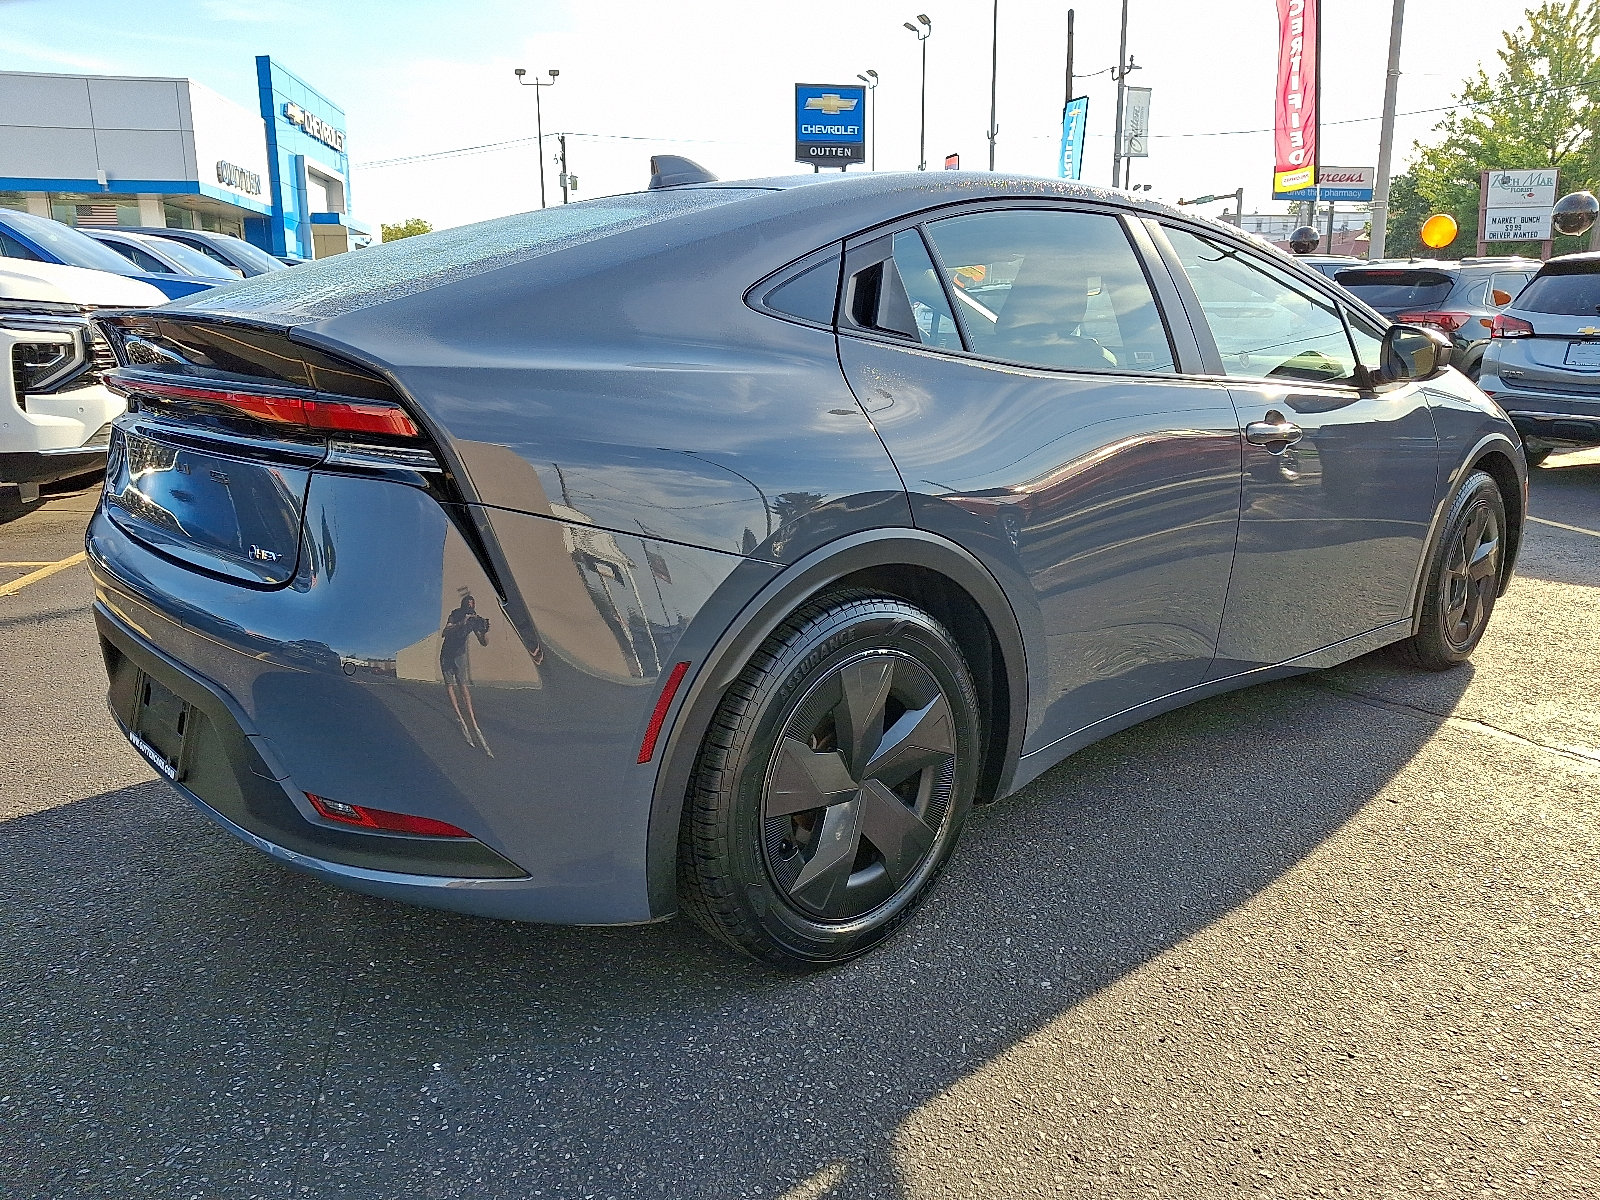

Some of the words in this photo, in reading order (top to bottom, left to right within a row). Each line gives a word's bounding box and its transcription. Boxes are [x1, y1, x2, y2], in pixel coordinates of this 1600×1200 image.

[303, 110, 345, 153] CHEVROLET
[801, 125, 860, 134] CHEVROLET
[810, 147, 852, 156] OUTTEN
[1324, 189, 1362, 198] pharmacy
[1491, 217, 1516, 225] MARKET
[1520, 216, 1541, 224] BUNCH
[1513, 231, 1539, 239] WANTED
[780, 627, 856, 698] ASSURANCE
